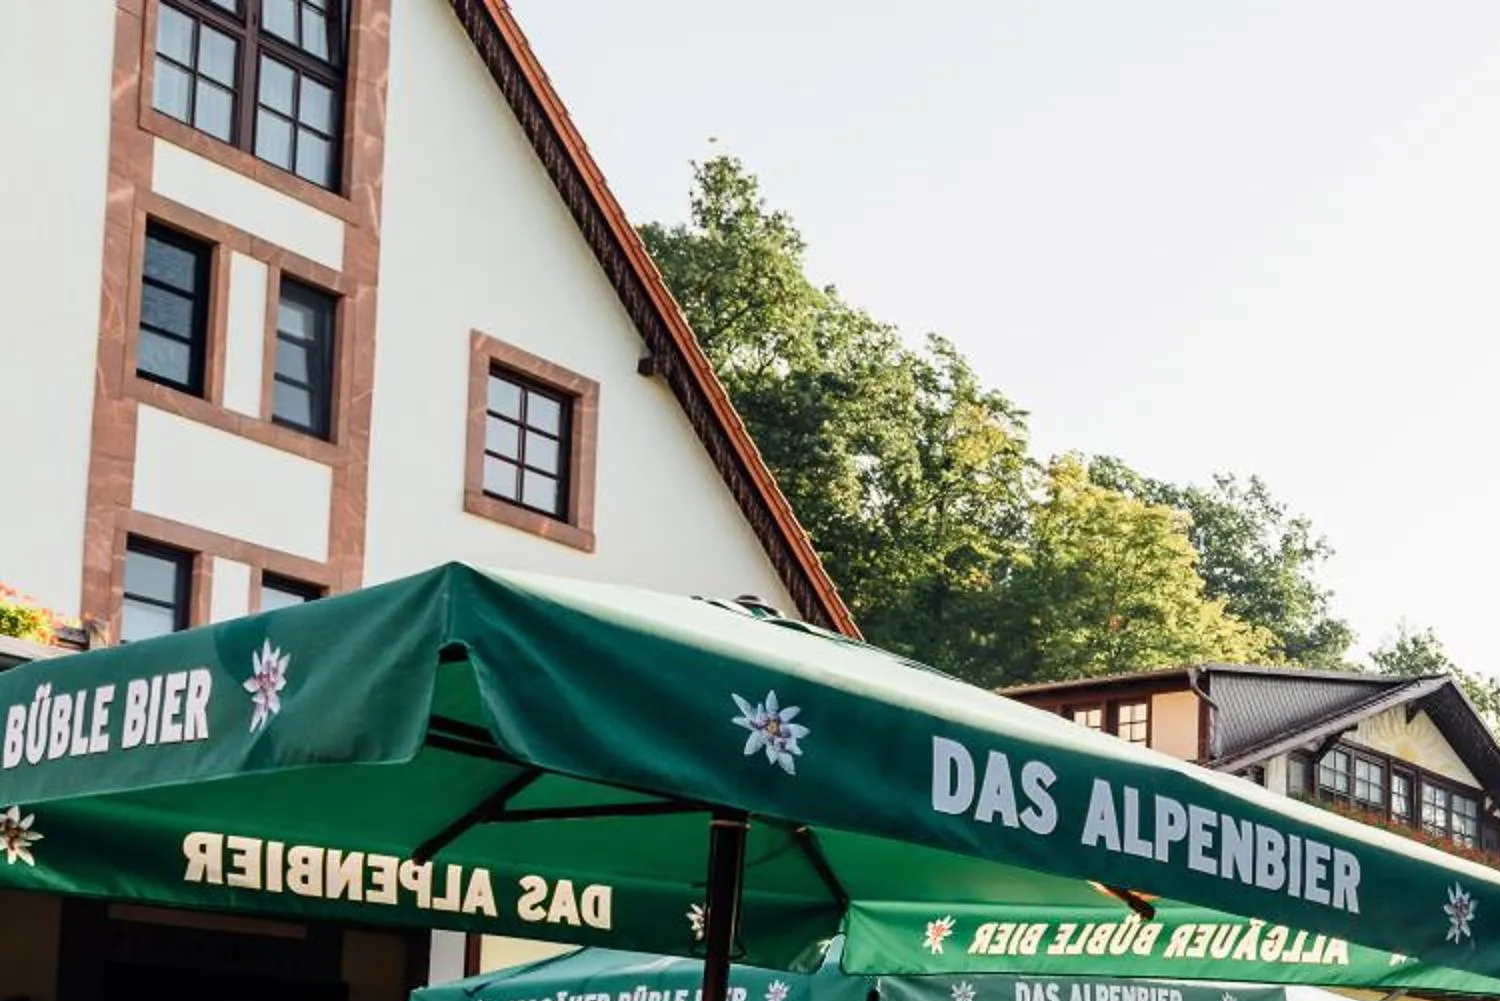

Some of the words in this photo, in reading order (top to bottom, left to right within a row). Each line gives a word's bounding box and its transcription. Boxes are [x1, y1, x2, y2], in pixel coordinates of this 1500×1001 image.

[3, 680, 115, 769] BÜBLE
[122, 669, 212, 748] BIER
[932, 736, 1057, 835] DAS
[1081, 779, 1361, 913] ALPENBIER
